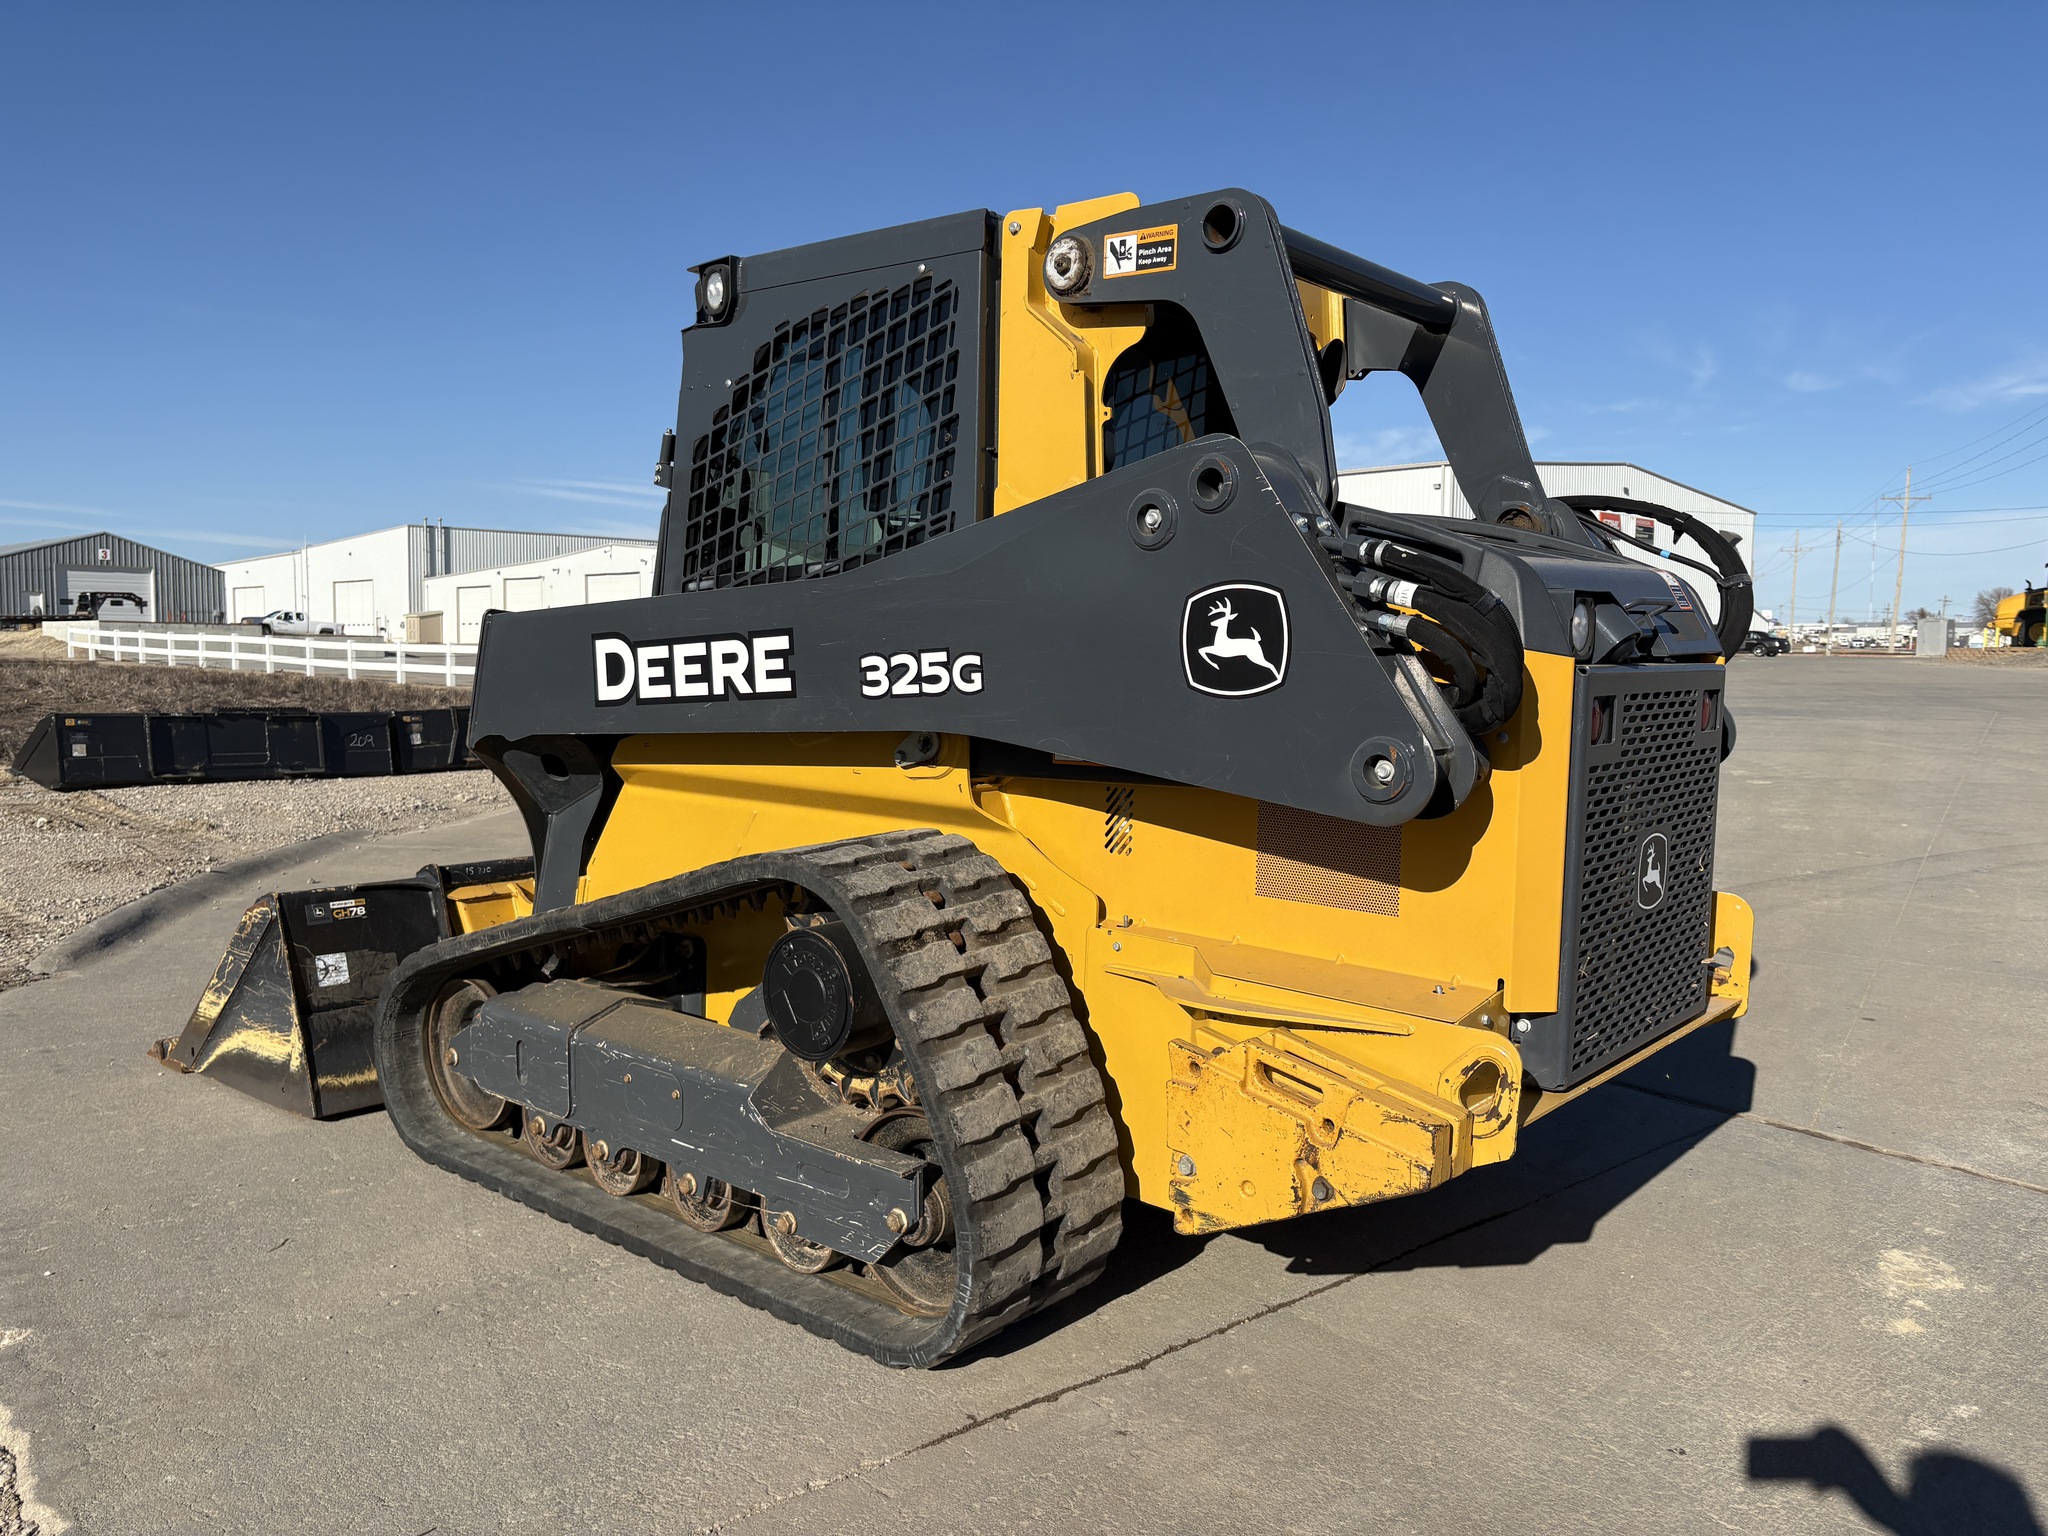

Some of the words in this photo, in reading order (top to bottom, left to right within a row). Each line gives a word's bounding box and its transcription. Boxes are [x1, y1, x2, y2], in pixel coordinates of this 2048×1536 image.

[1145, 229, 1174, 240] WARNING
[1138, 247, 1156, 257] Pinch
[1157, 245, 1172, 254] Area
[1138, 258, 1152, 266] Keep
[1153, 256, 1167, 264] Away
[101, 550, 107, 560] 3
[594, 635, 793, 701] DEERE
[859, 651, 983, 698] 325G
[350, 733, 375, 747] 209
[333, 906, 366, 919] GH78
